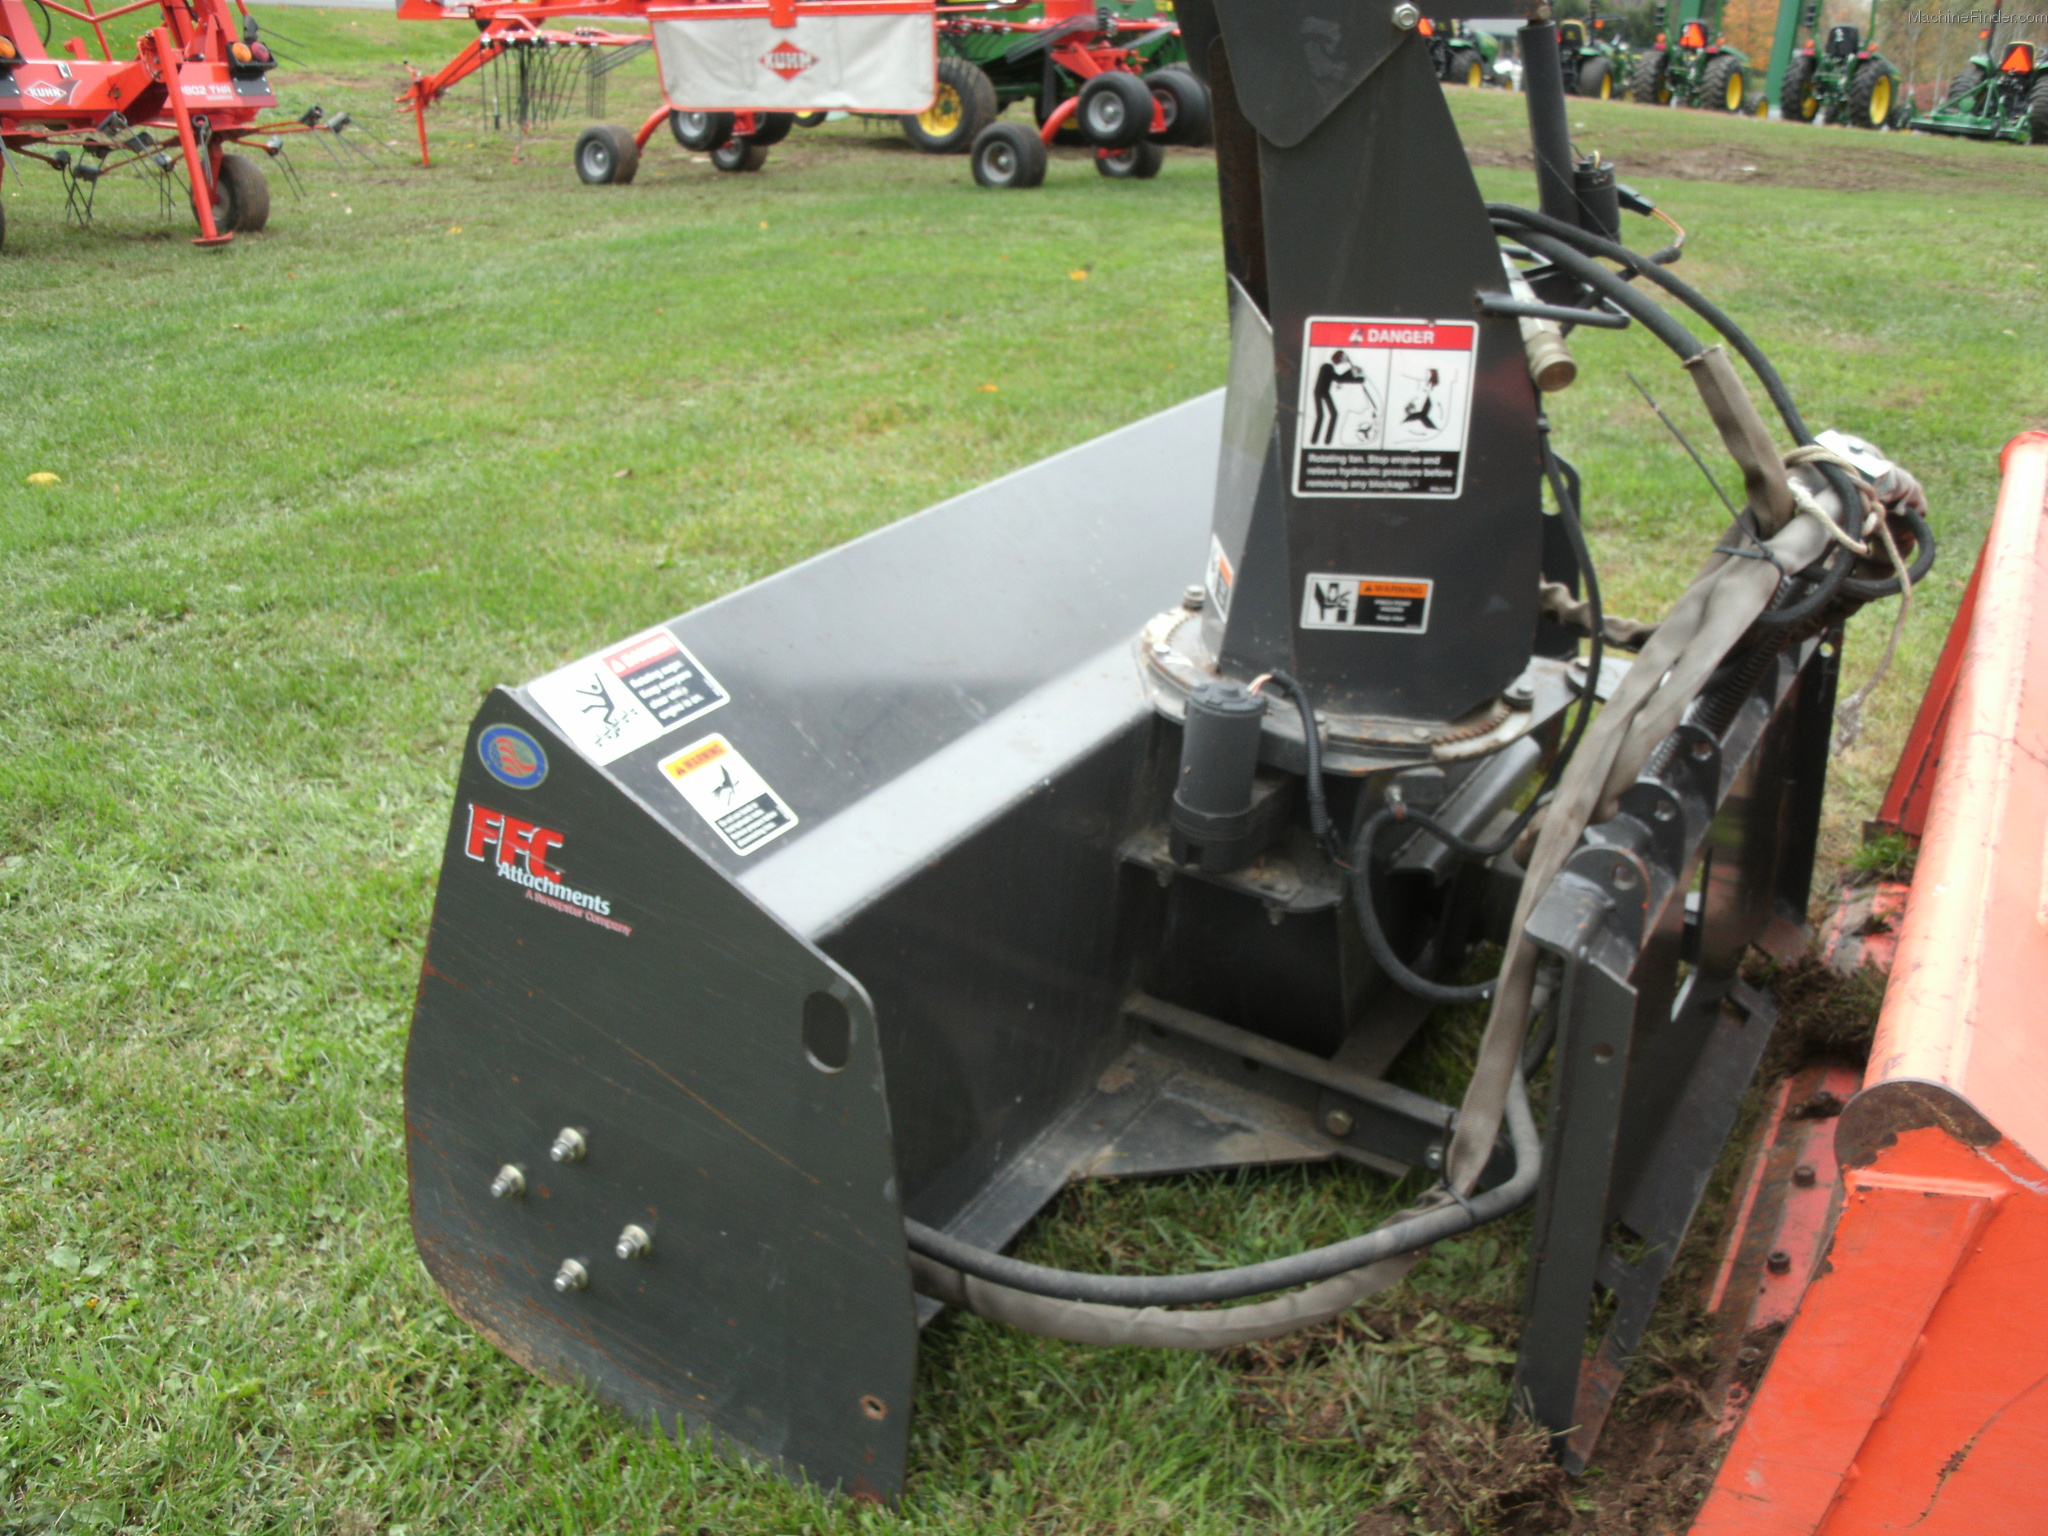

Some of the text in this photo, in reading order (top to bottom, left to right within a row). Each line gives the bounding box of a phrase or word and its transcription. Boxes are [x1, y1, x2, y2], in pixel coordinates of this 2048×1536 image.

[764, 52, 811, 69] KUHN
[28, 87, 62, 97] KUHN
[1367, 328, 1435, 344] DANGER
[1307, 453, 1347, 465] Rotating
[1367, 454, 1389, 466] Stop
[1390, 456, 1421, 467] engine
[1422, 455, 1441, 465] and
[1306, 466, 1453, 478] relieve hydraulic pressure before
[1305, 480, 1348, 490] removing
[1349, 481, 1367, 491] any
[1375, 585, 1423, 594] WARNING
[465, 803, 565, 884] FFC
[498, 861, 611, 916] Attachments
[525, 888, 533, 900] A
[585, 910, 633, 937] Company
